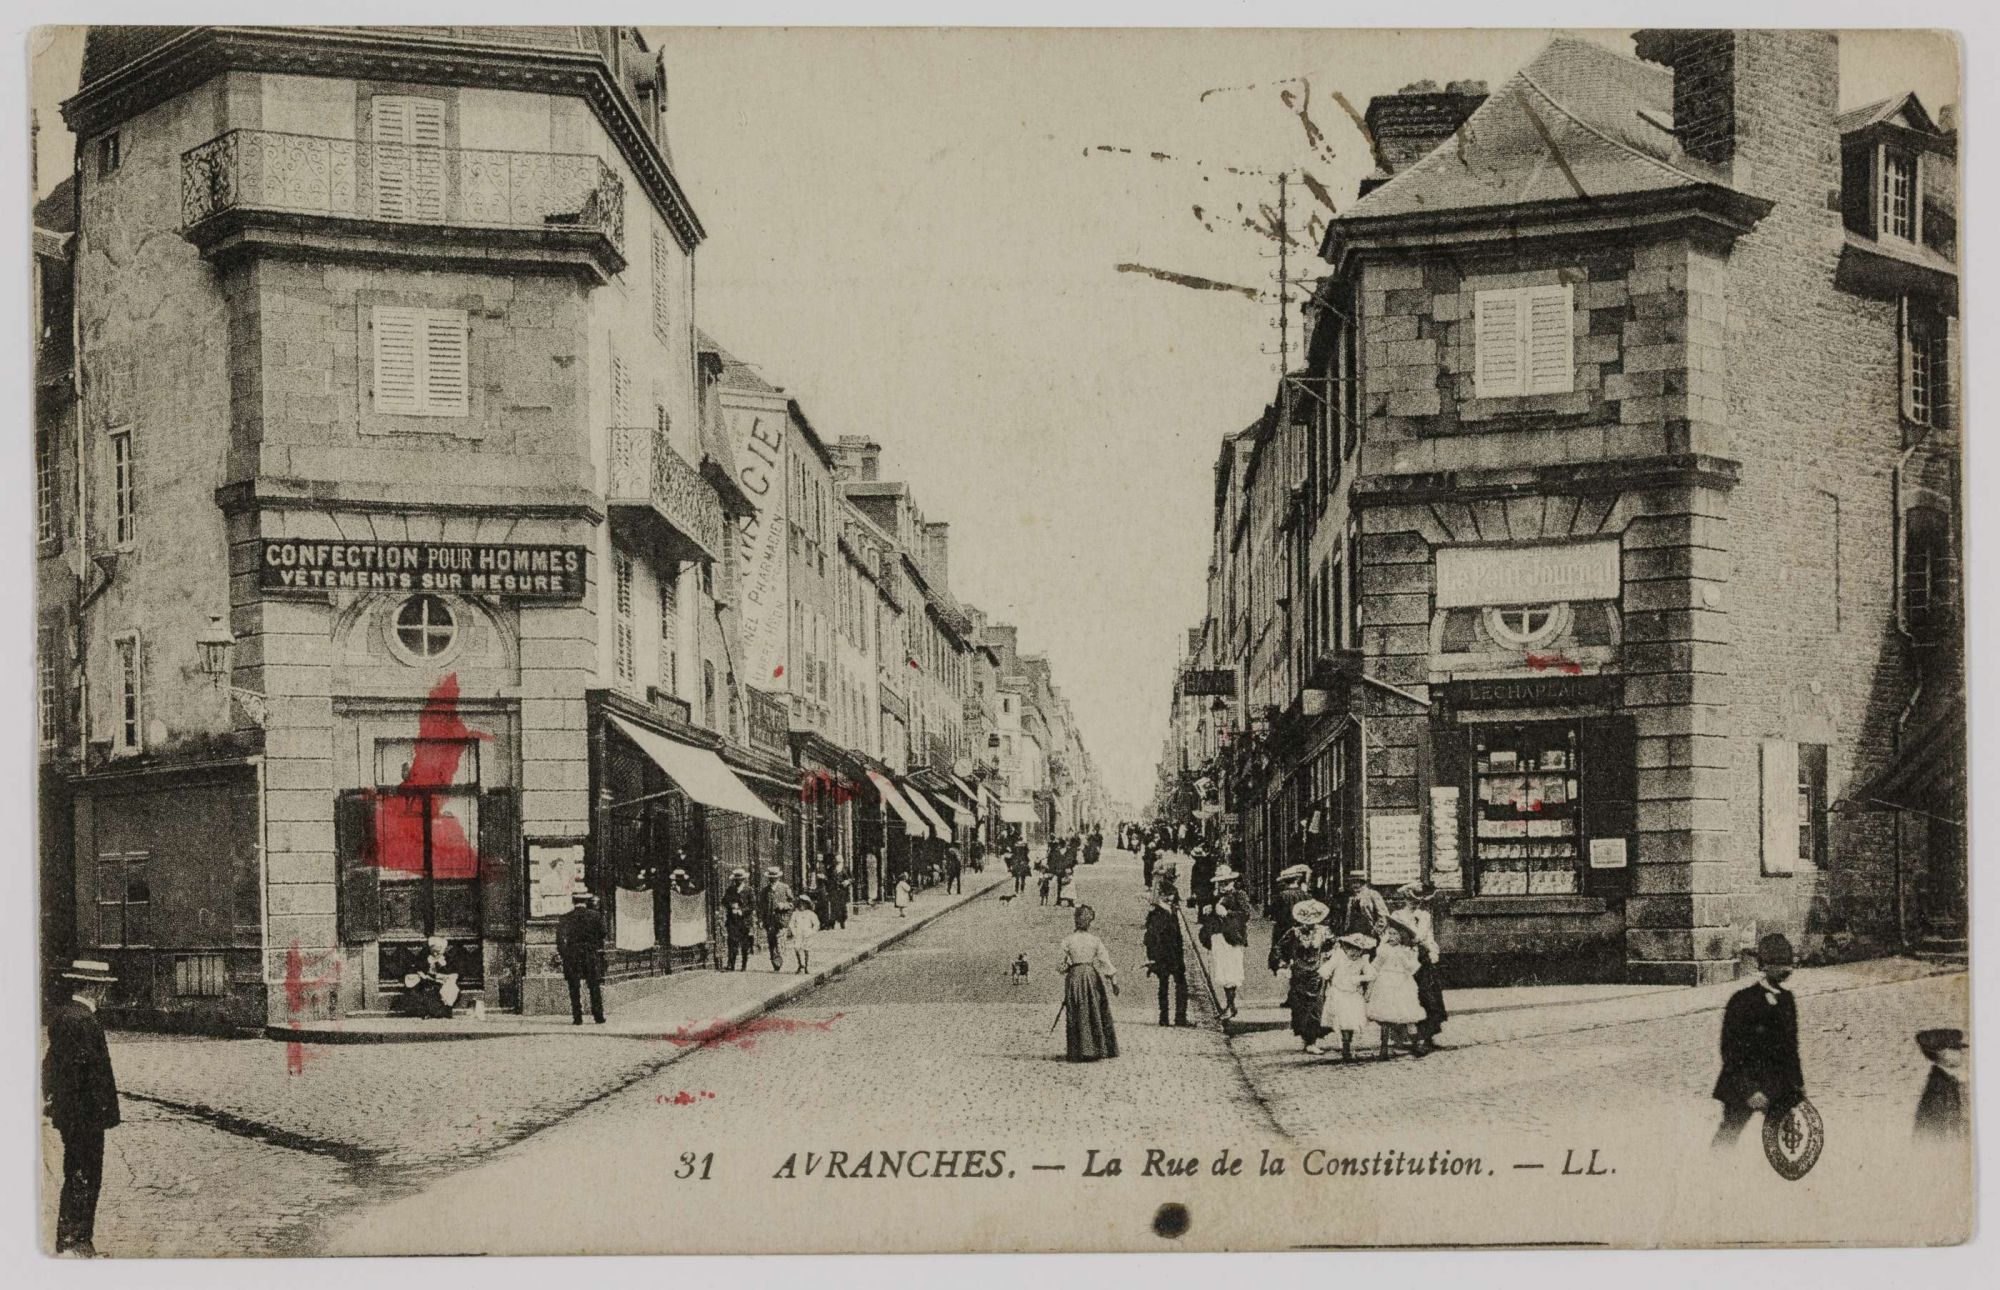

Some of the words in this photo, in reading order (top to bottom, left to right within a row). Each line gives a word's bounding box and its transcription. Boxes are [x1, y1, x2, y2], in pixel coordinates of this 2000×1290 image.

[266, 544, 418, 568] CONFECTION
[428, 547, 473, 570] POUR
[479, 549, 578, 573] HOMMES
[281, 567, 411, 588] VÊTEMENTS
[422, 573, 462, 589] SUR
[471, 574, 563, 591] MESURE
